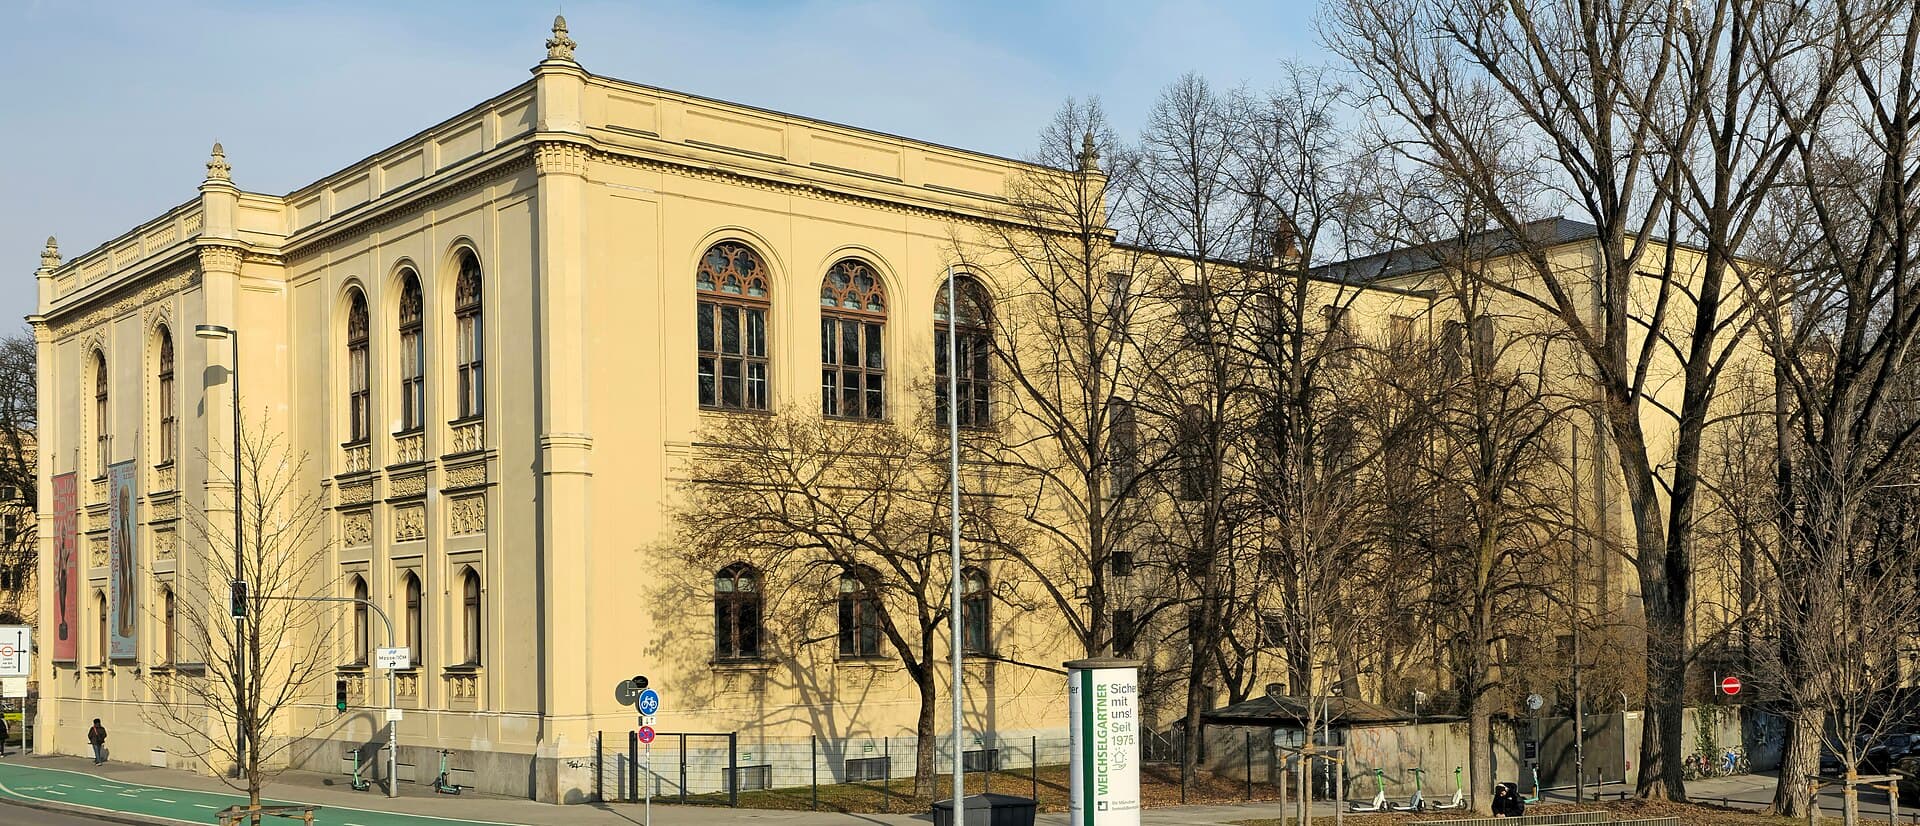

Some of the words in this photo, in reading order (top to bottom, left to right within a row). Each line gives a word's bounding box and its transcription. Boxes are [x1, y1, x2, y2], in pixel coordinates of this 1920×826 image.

[1111, 696, 1128, 707] mit
[1111, 708, 1132, 719] uns!
[1111, 722, 1131, 733] Seit
[1097, 684, 1108, 796] WEICHSELGARTNER
[1111, 735, 1136, 746] 1975.
